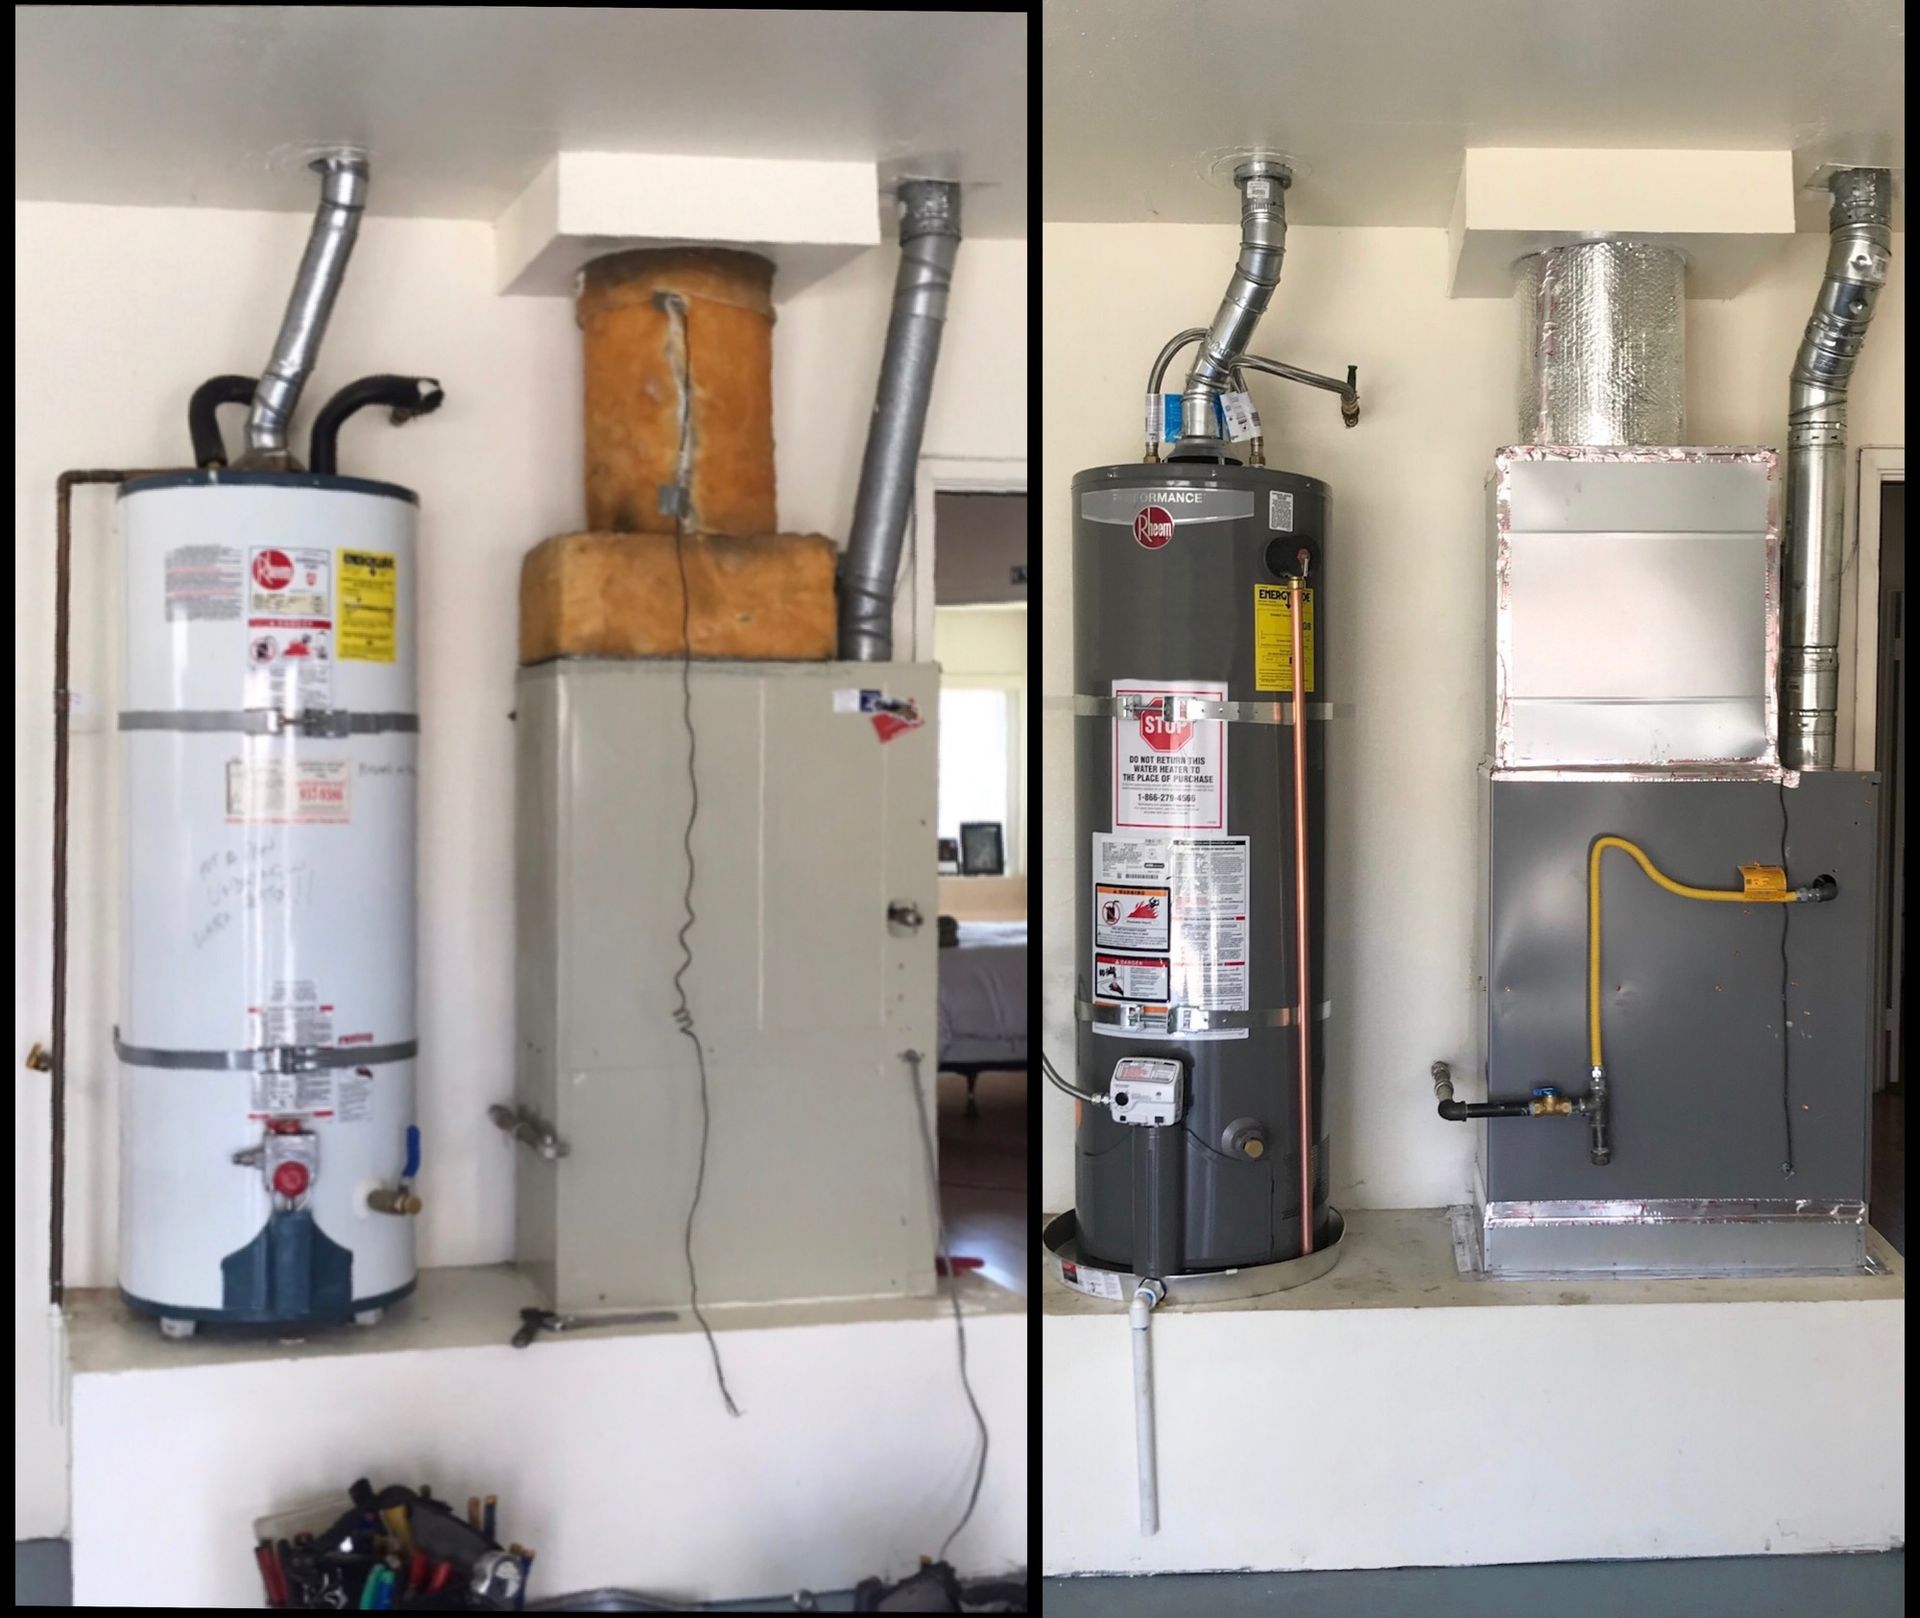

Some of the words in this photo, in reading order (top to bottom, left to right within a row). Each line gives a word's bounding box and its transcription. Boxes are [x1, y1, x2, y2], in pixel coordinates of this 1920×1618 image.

[1138, 507, 1172, 542] Rheem
[1129, 755, 1139, 764] DO
[1140, 756, 1154, 764] NOT
[1156, 756, 1186, 765] RETURN
[1187, 756, 1206, 765] THIS
[1133, 765, 1158, 773] WATER
[1160, 765, 1188, 774] HEATER
[1191, 766, 1201, 774] TO
[1123, 773, 1135, 781] THE
[1137, 774, 1160, 782] PLACE
[1161, 774, 1171, 782] OF
[1173, 775, 1214, 783] PURCHASE
